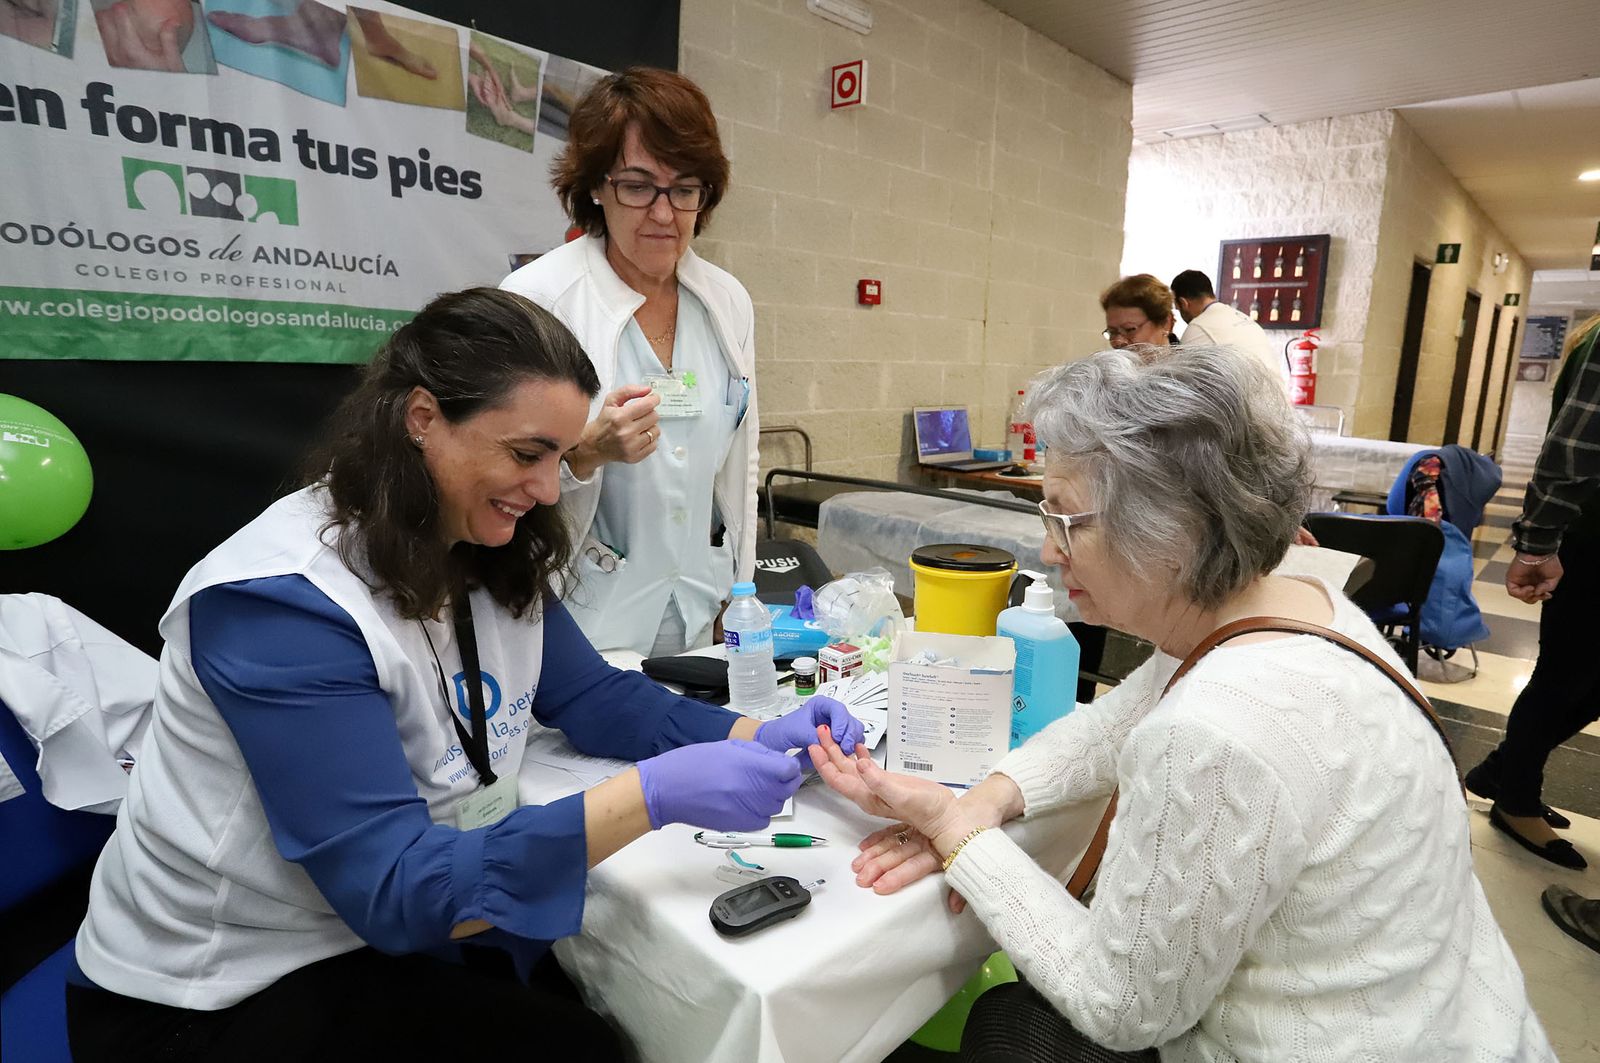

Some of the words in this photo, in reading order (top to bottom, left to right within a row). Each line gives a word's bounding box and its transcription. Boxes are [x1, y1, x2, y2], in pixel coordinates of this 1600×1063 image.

[80, 81, 281, 162] forma
[292, 129, 378, 179] tus
[387, 147, 483, 199] pies
[208, 234, 244, 262] de
[252, 246, 400, 277] ANDALUCÍA
[75, 263, 187, 283] COLEGIO
[200, 272, 347, 294] PROFESIONAL
[755, 556, 800, 569] PUSH
